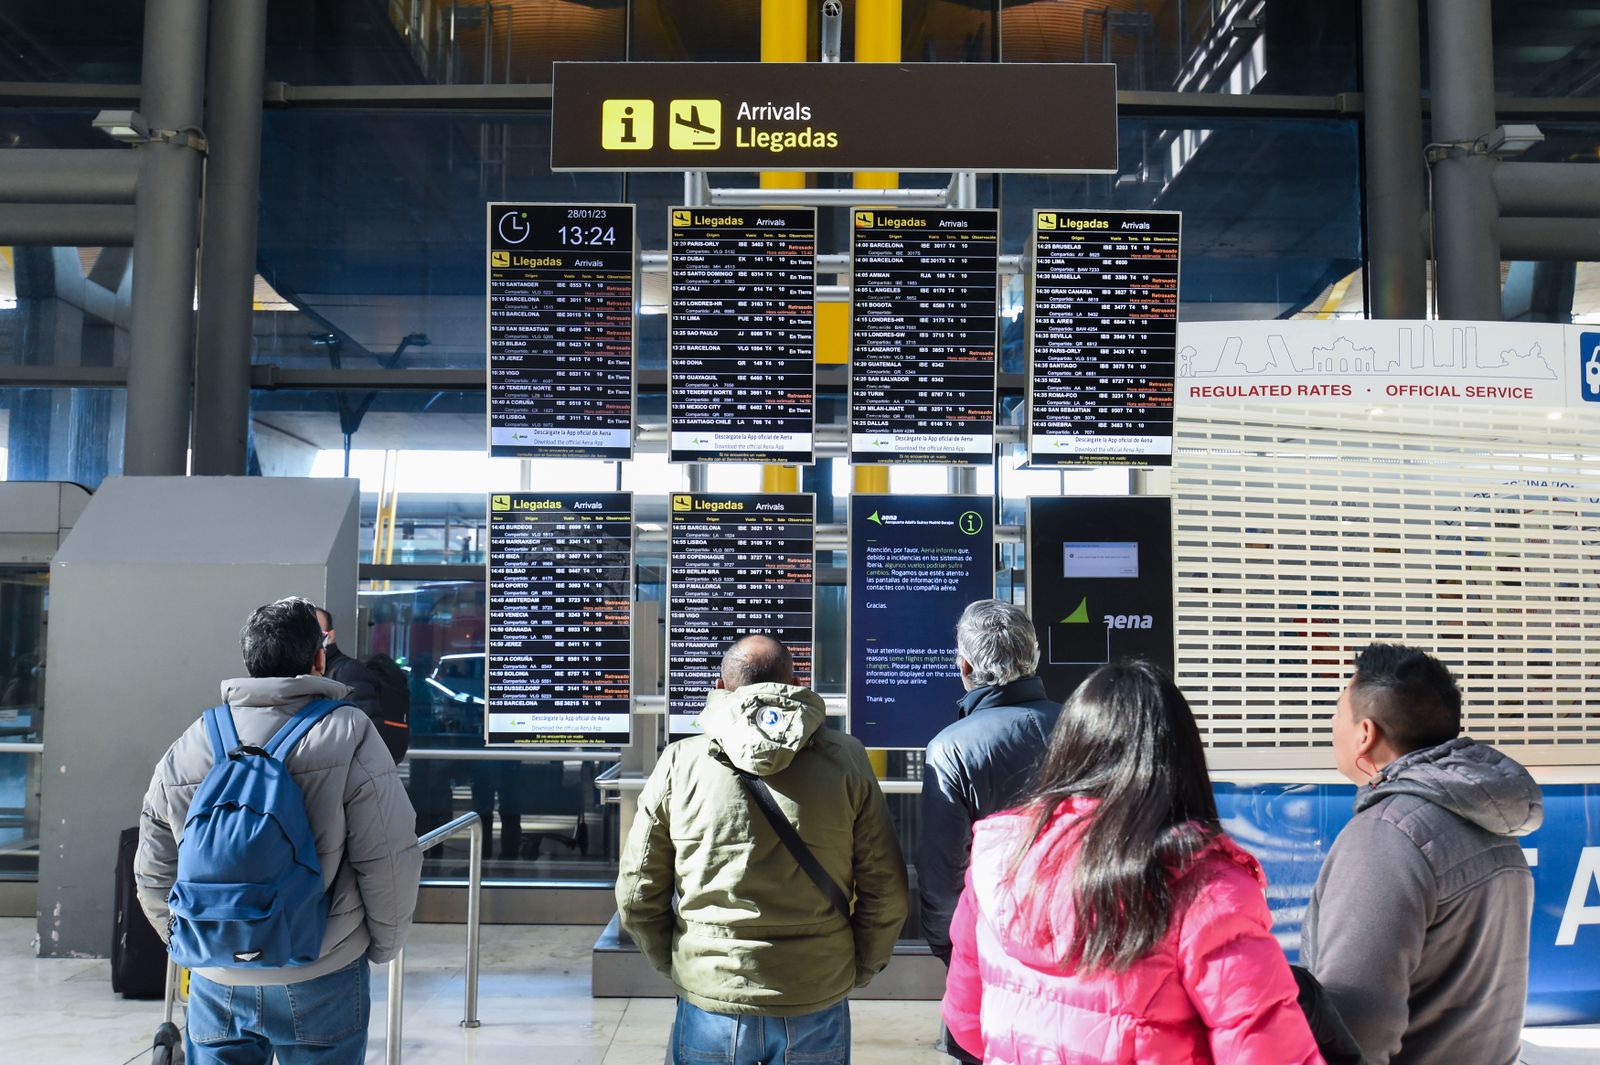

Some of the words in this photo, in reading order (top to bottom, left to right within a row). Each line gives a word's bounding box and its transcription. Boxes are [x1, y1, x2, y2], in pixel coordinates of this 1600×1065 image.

[737, 102, 811, 121] Arrivals
[736, 128, 839, 153] Llegadas
[568, 210, 606, 218] 28/01/23
[695, 216, 744, 226] Llegadas
[877, 217, 926, 228] Llegadas
[1060, 219, 1109, 229] Llegadas
[1121, 222, 1150, 230] Arrivals
[558, 226, 616, 245] 13:24
[514, 257, 562, 266] Llegadas
[1190, 385, 1292, 398] REGULATED
[1297, 385, 1352, 397] RATES
[1386, 385, 1460, 397] OFFICIAL
[1466, 386, 1534, 399] SERVICE
[514, 499, 562, 510] Llegadas
[695, 500, 743, 510] Llegadas
[1104, 615, 1153, 629] aena
